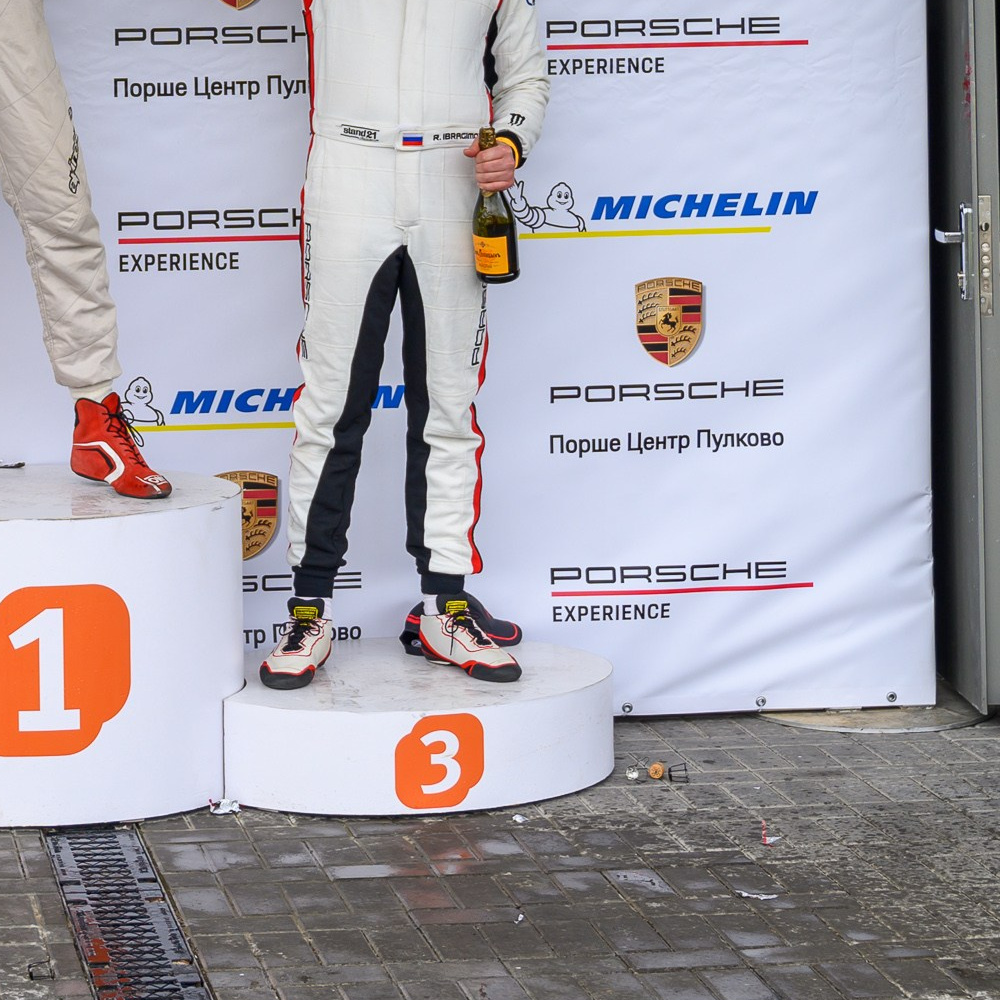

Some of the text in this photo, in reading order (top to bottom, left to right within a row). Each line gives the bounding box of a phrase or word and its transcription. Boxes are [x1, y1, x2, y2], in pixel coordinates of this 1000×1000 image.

[546, 17, 780, 38] PORSCHE
[548, 57, 664, 75] EXPERIENCE
[114, 78, 187, 102] Порше
[195, 77, 260, 100] Центр
[591, 190, 818, 217] MICHELIN
[120, 252, 239, 272] EXPERIENCE
[637, 279, 700, 292] PORSCHE
[551, 379, 783, 403] PORSCHE
[550, 429, 783, 455] Порше Центр Пулково
[551, 562, 787, 585] PORSCHE
[553, 603, 670, 622] EXPERIENCE
[9, 608, 80, 731] 1
[420, 730, 461, 794] 3
